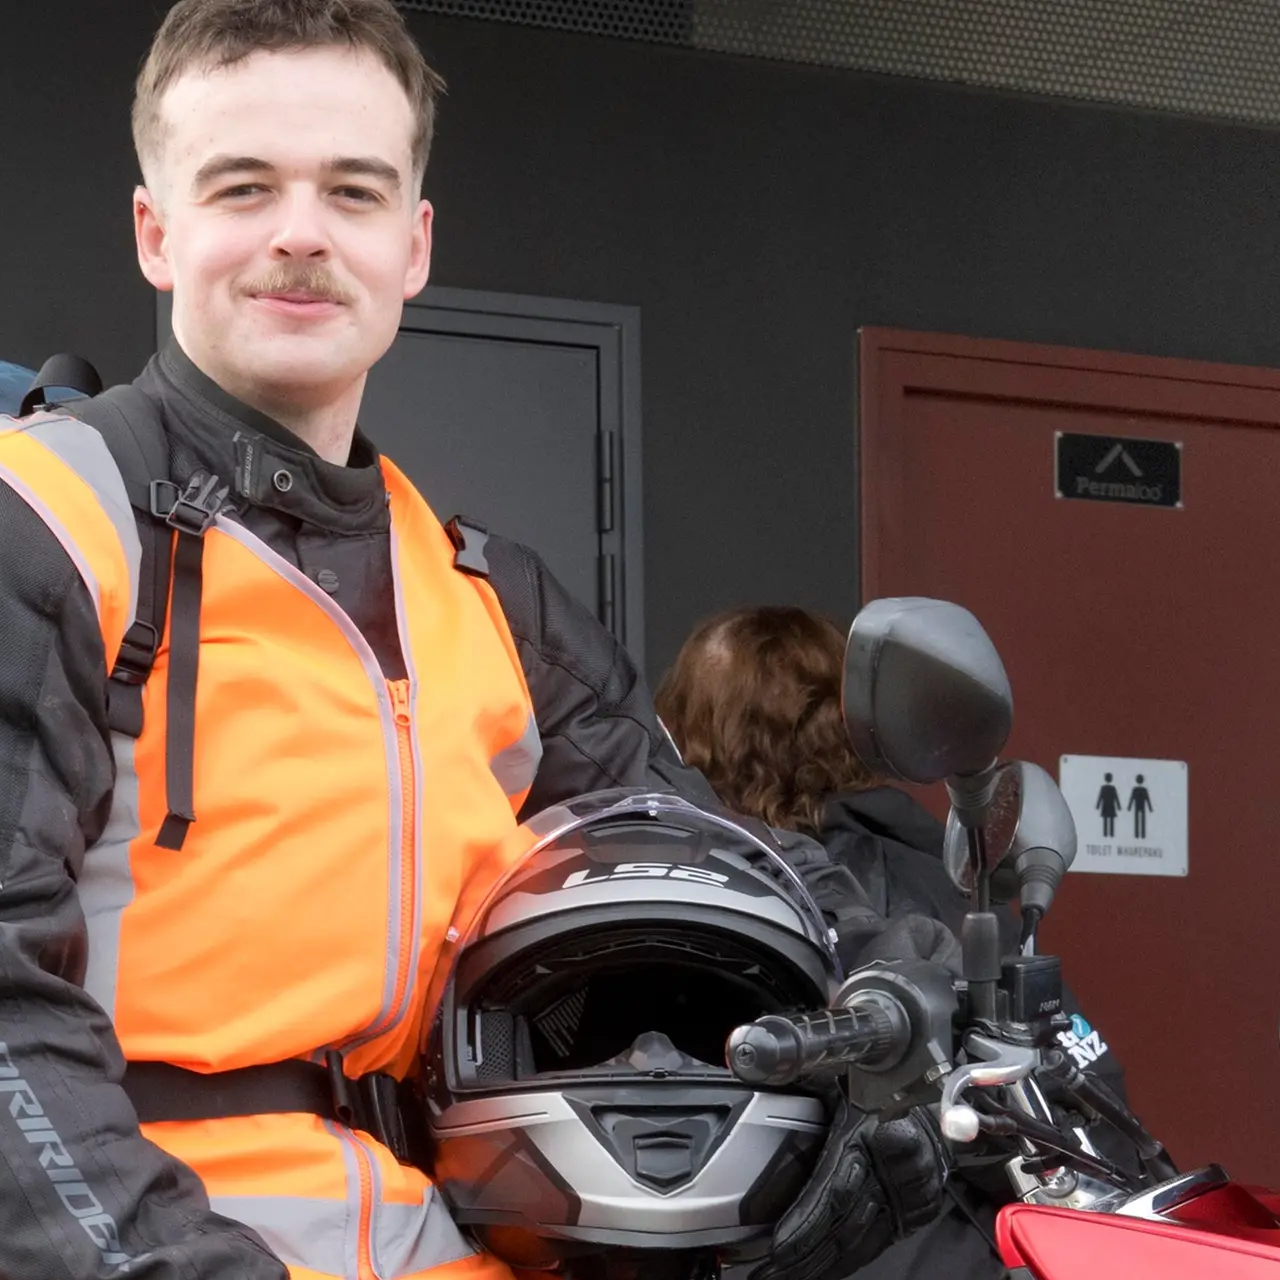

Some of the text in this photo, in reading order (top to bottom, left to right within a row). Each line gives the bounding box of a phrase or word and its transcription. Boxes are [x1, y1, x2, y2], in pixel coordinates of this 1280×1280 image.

[1076, 475, 1161, 501] Permaloo
[1085, 844, 1112, 857] TOILET
[562, 862, 730, 889] LS2
